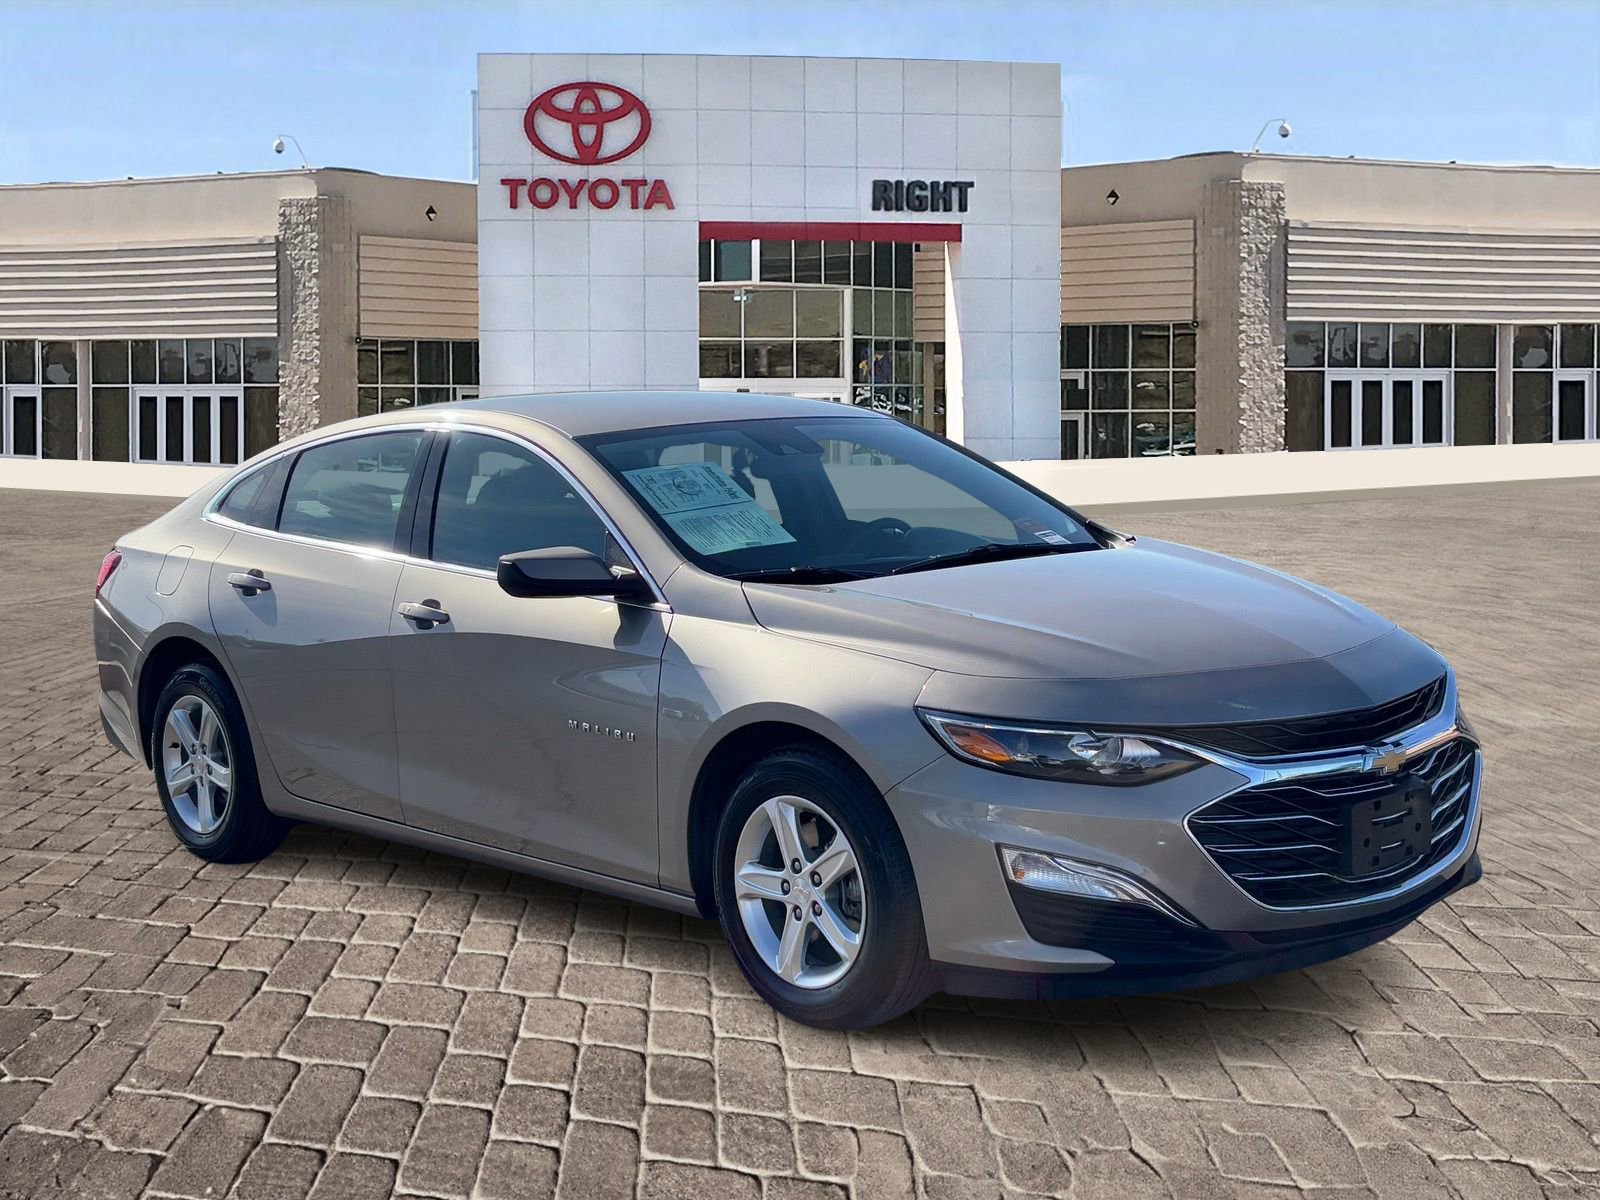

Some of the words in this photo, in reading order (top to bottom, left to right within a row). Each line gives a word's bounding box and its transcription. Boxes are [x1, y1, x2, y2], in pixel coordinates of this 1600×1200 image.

[501, 178, 674, 208] TOYOTA
[872, 179, 975, 212] RIGHT
[568, 719, 635, 742] MALIBU
